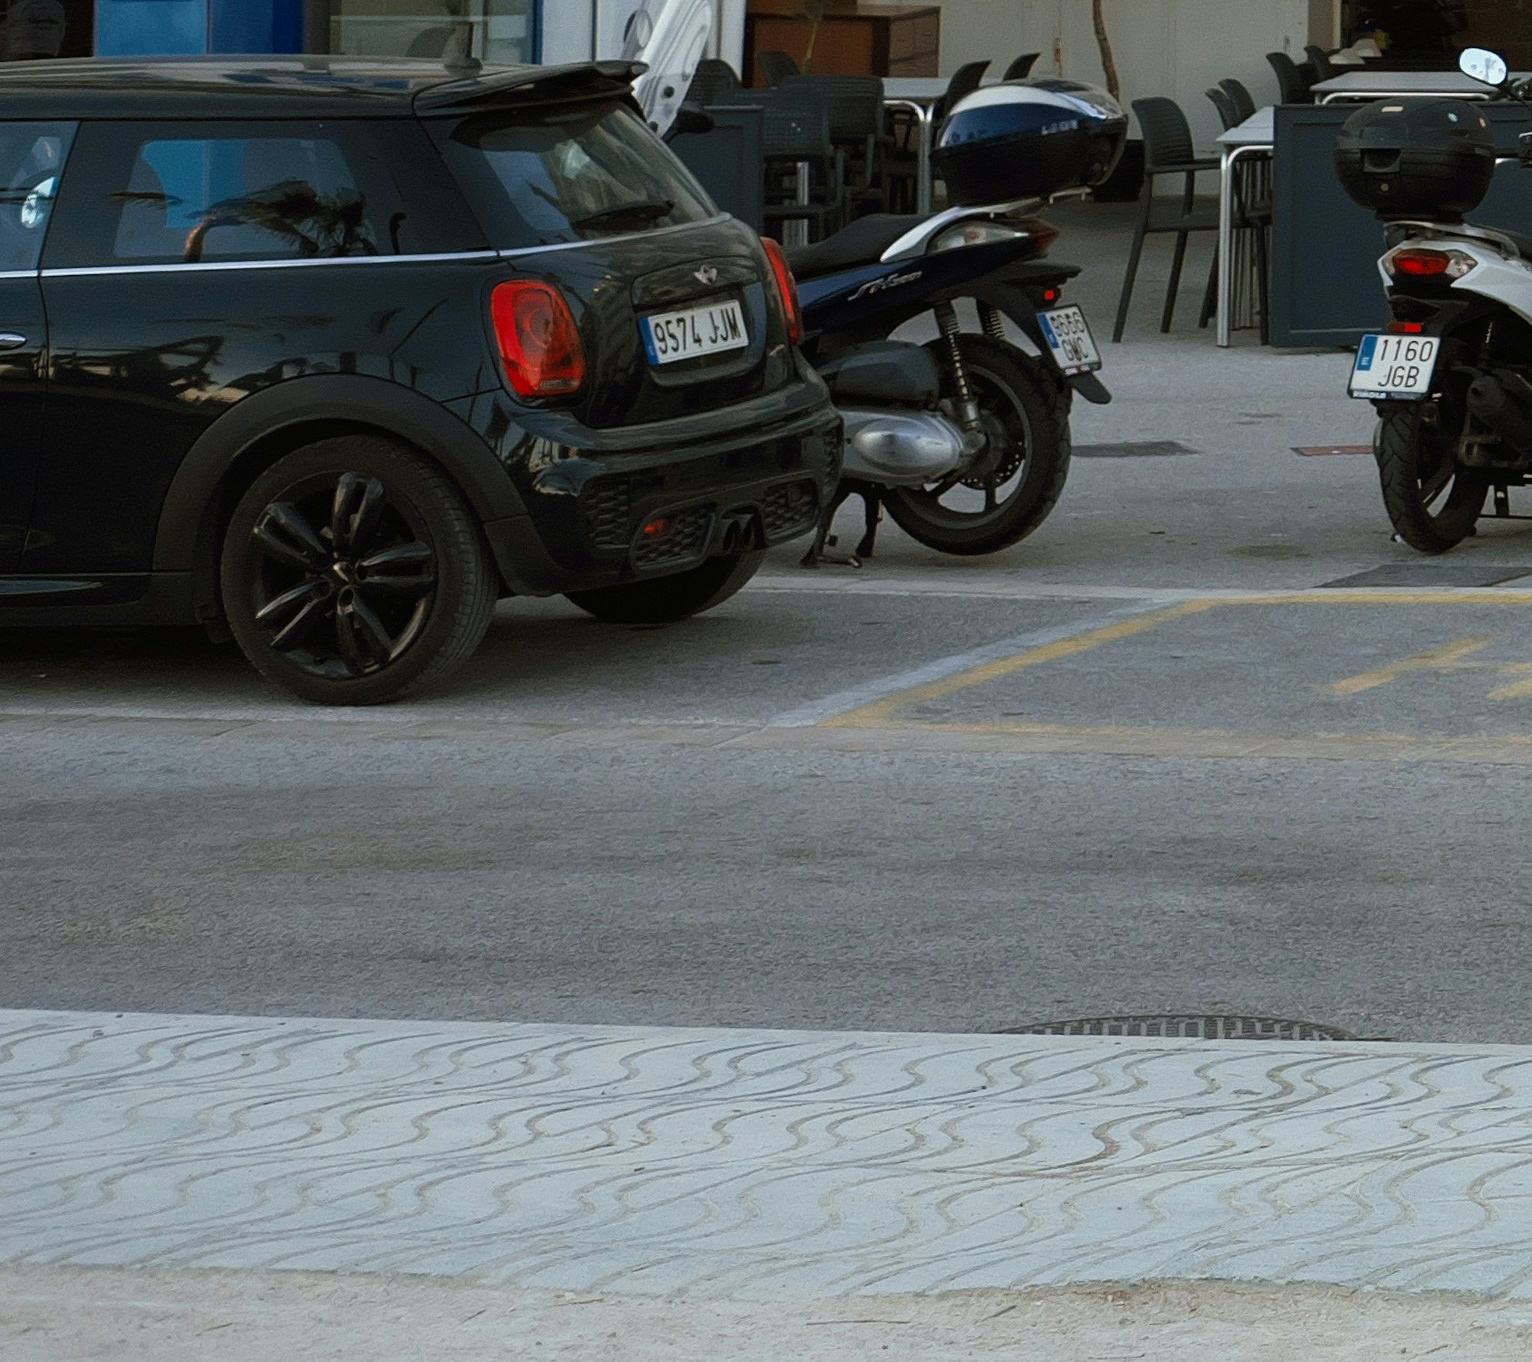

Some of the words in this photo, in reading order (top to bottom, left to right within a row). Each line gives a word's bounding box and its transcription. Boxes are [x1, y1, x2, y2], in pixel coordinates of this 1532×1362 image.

[653, 314, 702, 355] 9574
[1381, 339, 1434, 362] 1160
[1378, 365, 1420, 388] JGB
